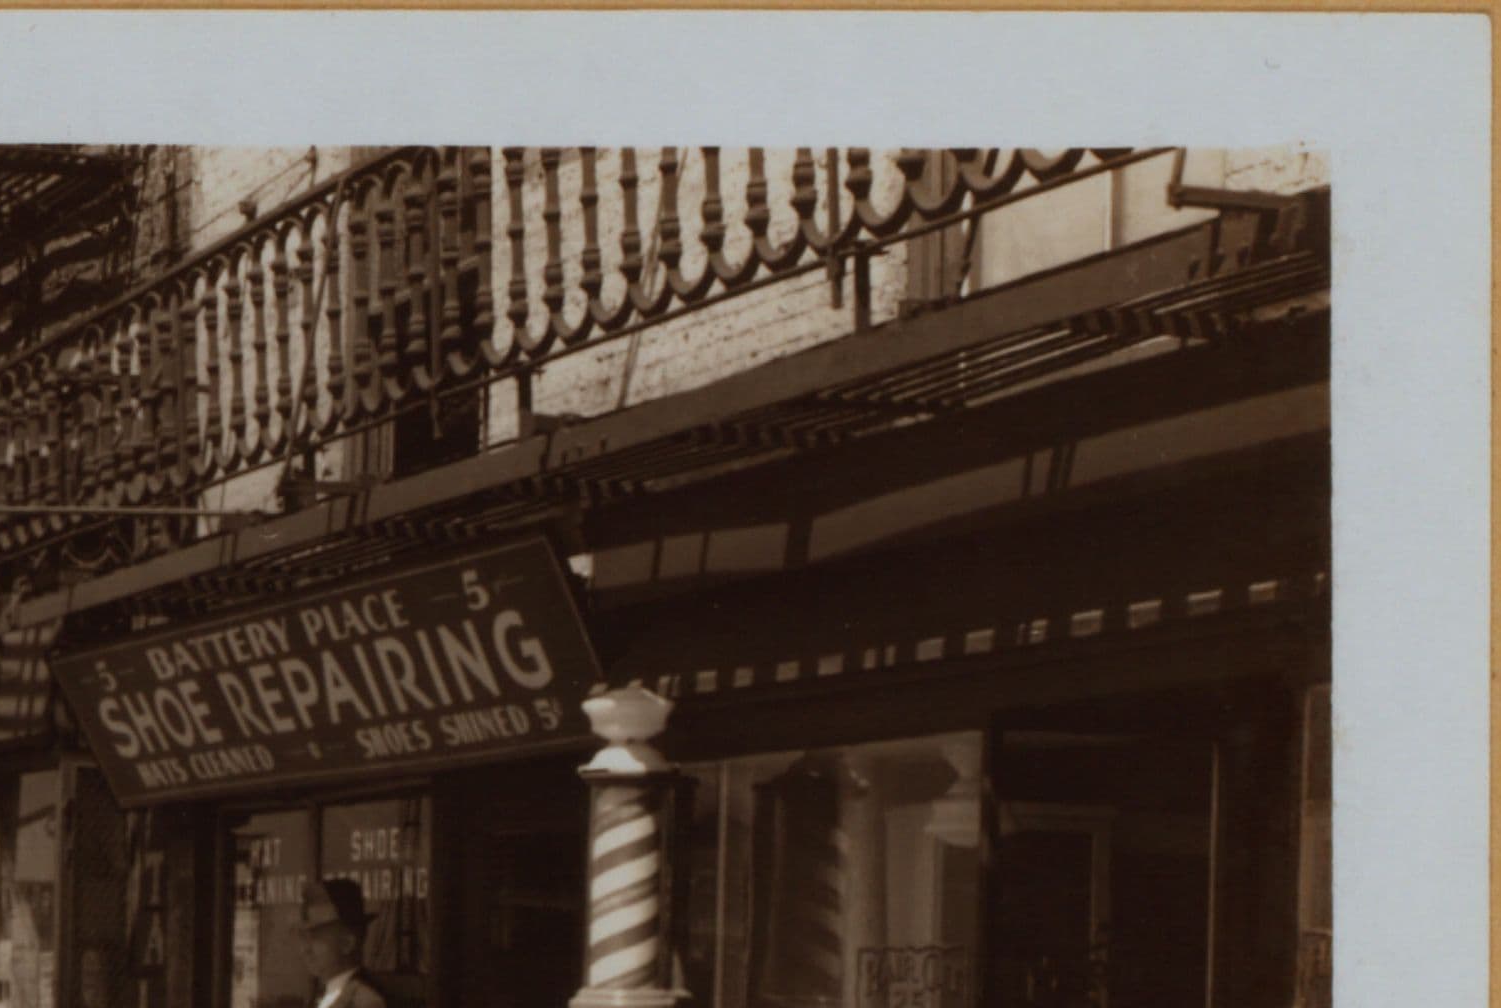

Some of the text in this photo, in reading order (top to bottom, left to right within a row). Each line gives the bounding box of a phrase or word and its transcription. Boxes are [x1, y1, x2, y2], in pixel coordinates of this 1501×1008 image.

[145, 616, 290, 680] BATTERY
[298, 588, 410, 646] PLACE
[98, 609, 554, 758] SHOE REPAIRING
[354, 719, 433, 760] SHOES
[438, 704, 531, 747] SHINED
[135, 743, 275, 788] HATS CLEANED
[350, 827, 399, 861] SHOE
